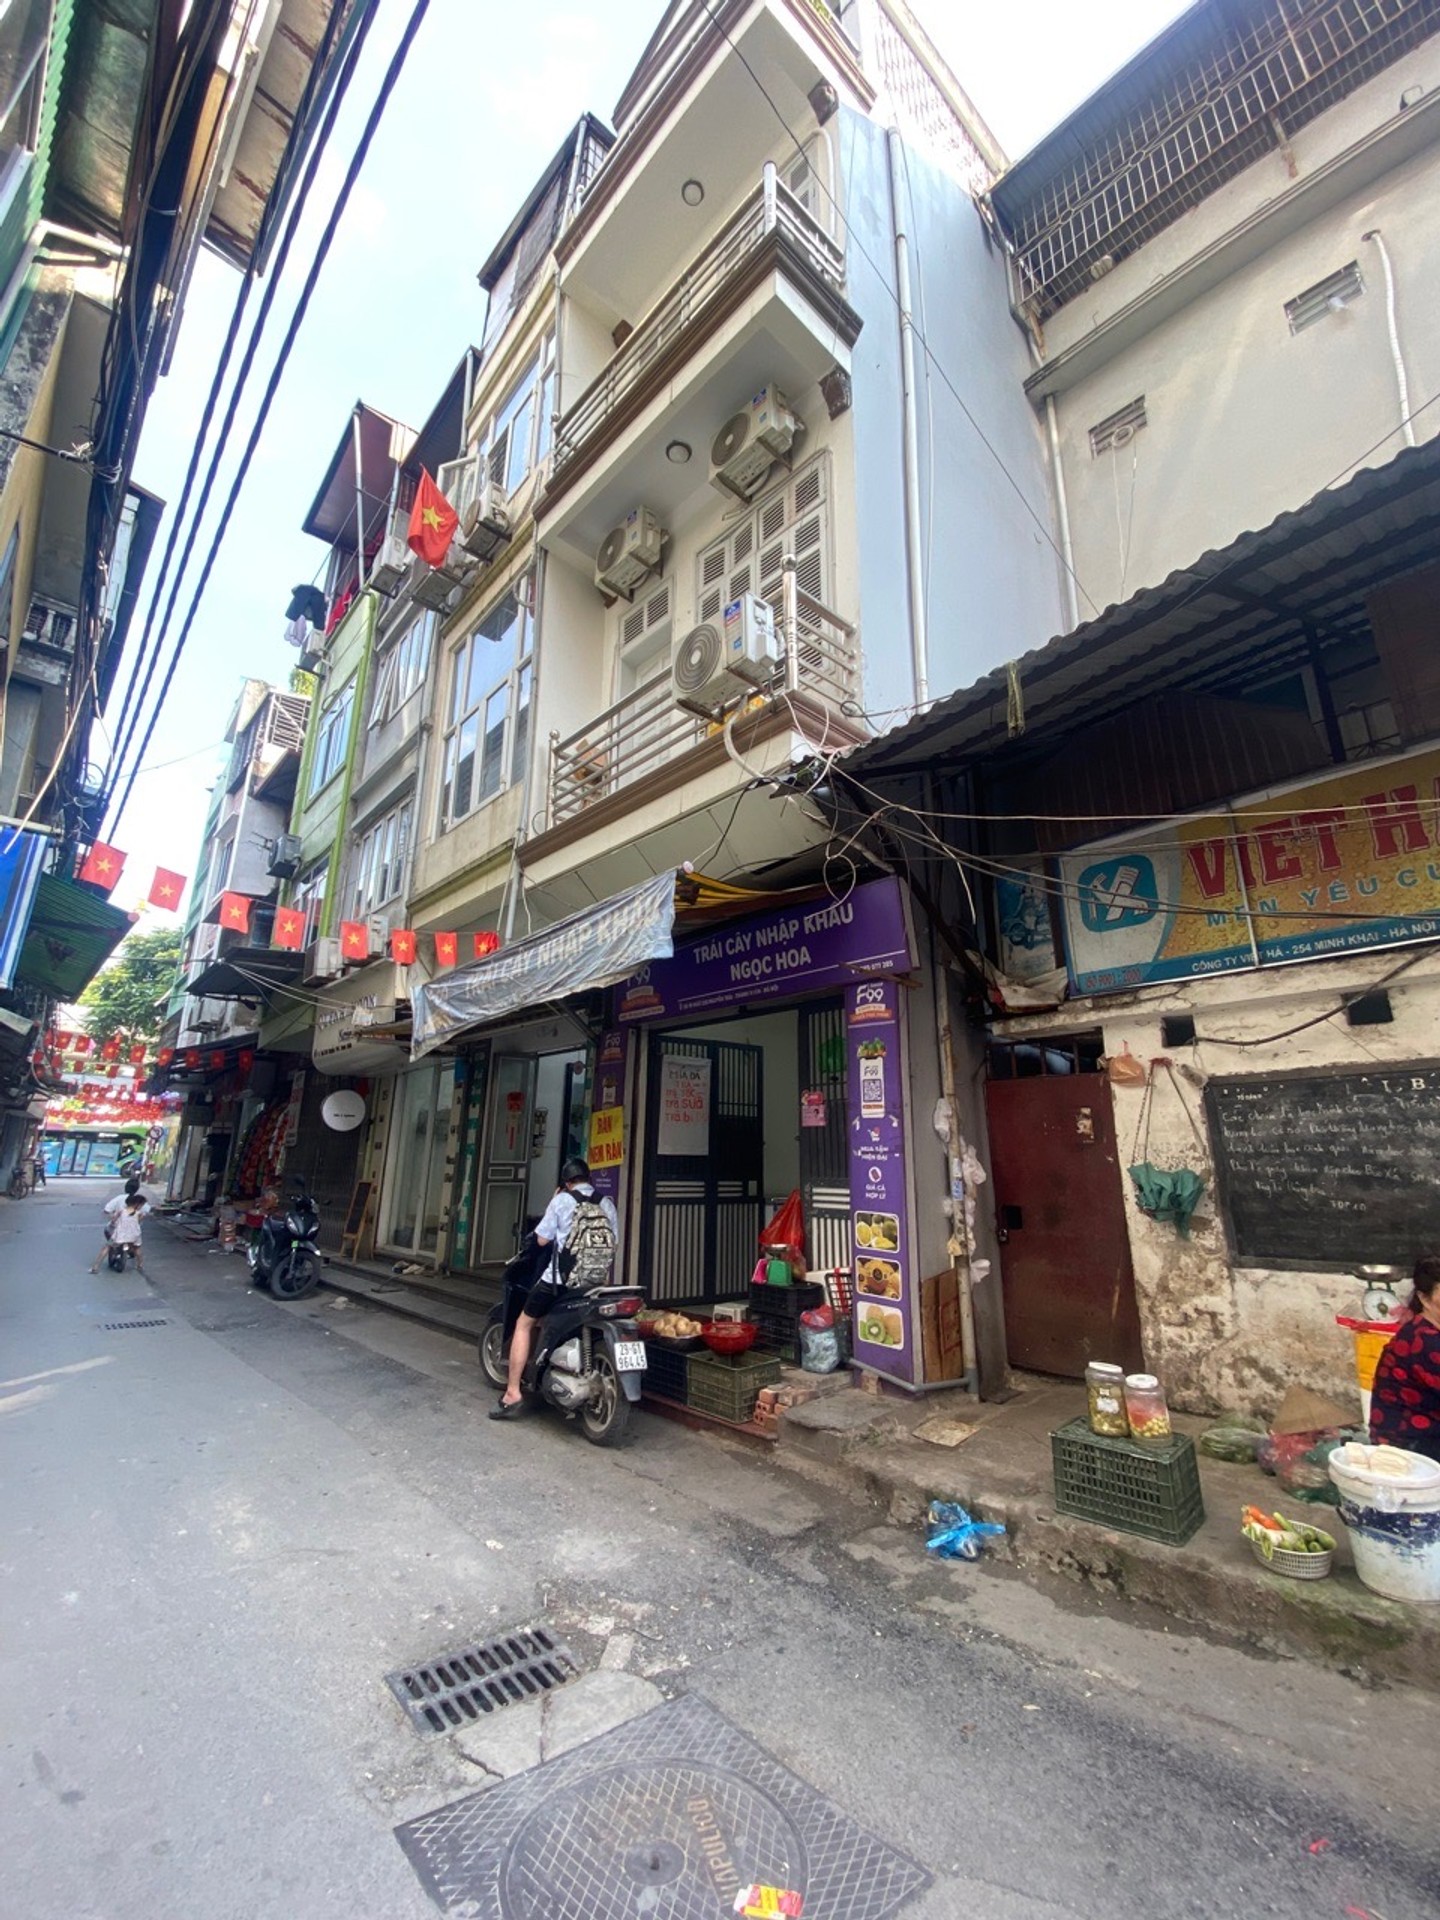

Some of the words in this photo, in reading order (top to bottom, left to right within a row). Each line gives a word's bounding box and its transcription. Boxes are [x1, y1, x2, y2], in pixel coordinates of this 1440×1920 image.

[1361, 777, 1440, 861] H
[1301, 877, 1379, 907] YÊU
[693, 938, 722, 965] TRÁI
[726, 931, 752, 956] CÂY
[755, 918, 799, 949] NHẬP
[1191, 960, 1222, 972] CÔNG
[1225, 955, 1238, 967] TY
[1292, 943, 1312, 955] 254
[1314, 938, 1345, 951] MINH
[1349, 932, 1379, 945] KHAI
[1411, 920, 1436, 935] NỘI
[730, 954, 772, 981] NGỌC
[775, 946, 811, 972] HOA
[857, 983, 884, 1004] F99
[618, 1355, 646, 1369] 964.45
